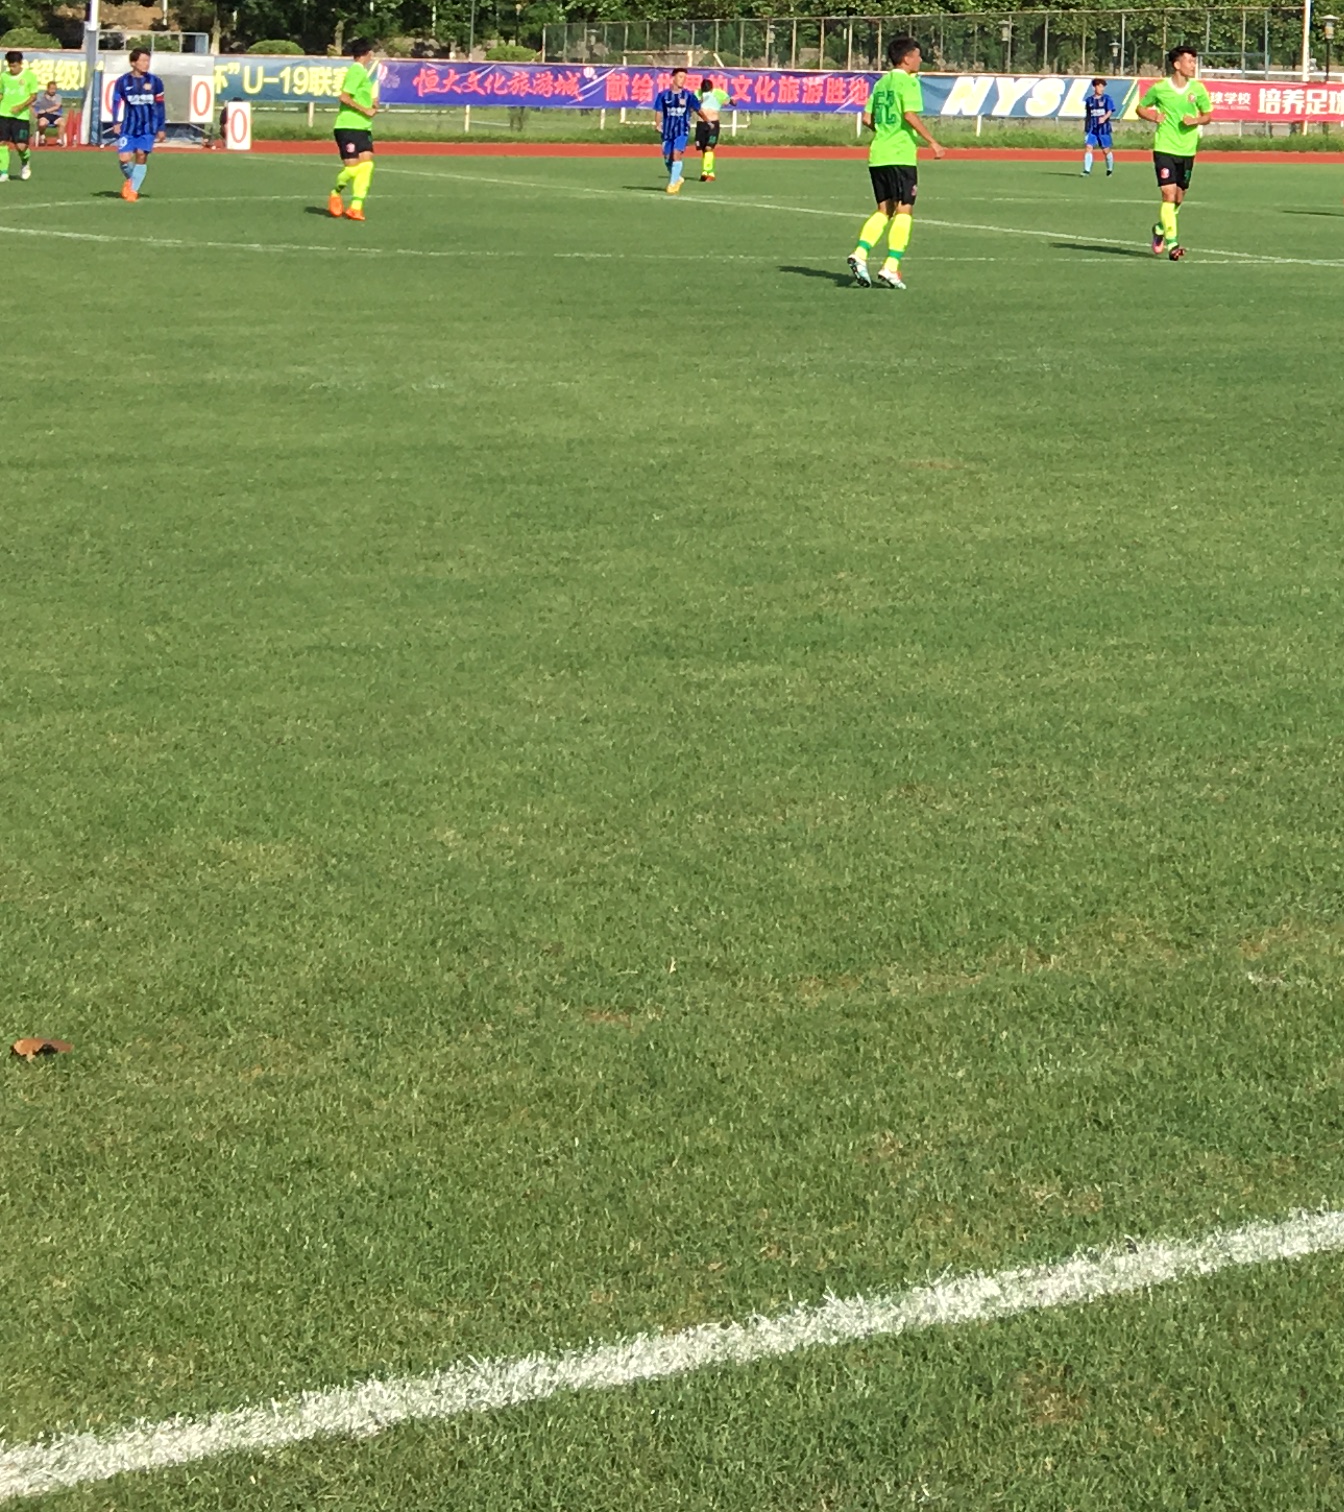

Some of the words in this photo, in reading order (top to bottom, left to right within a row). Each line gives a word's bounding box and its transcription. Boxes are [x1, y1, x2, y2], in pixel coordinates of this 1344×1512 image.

[412, 68, 583, 102] 恒大文化旅游城
[940, 76, 1093, 117] NYSL
